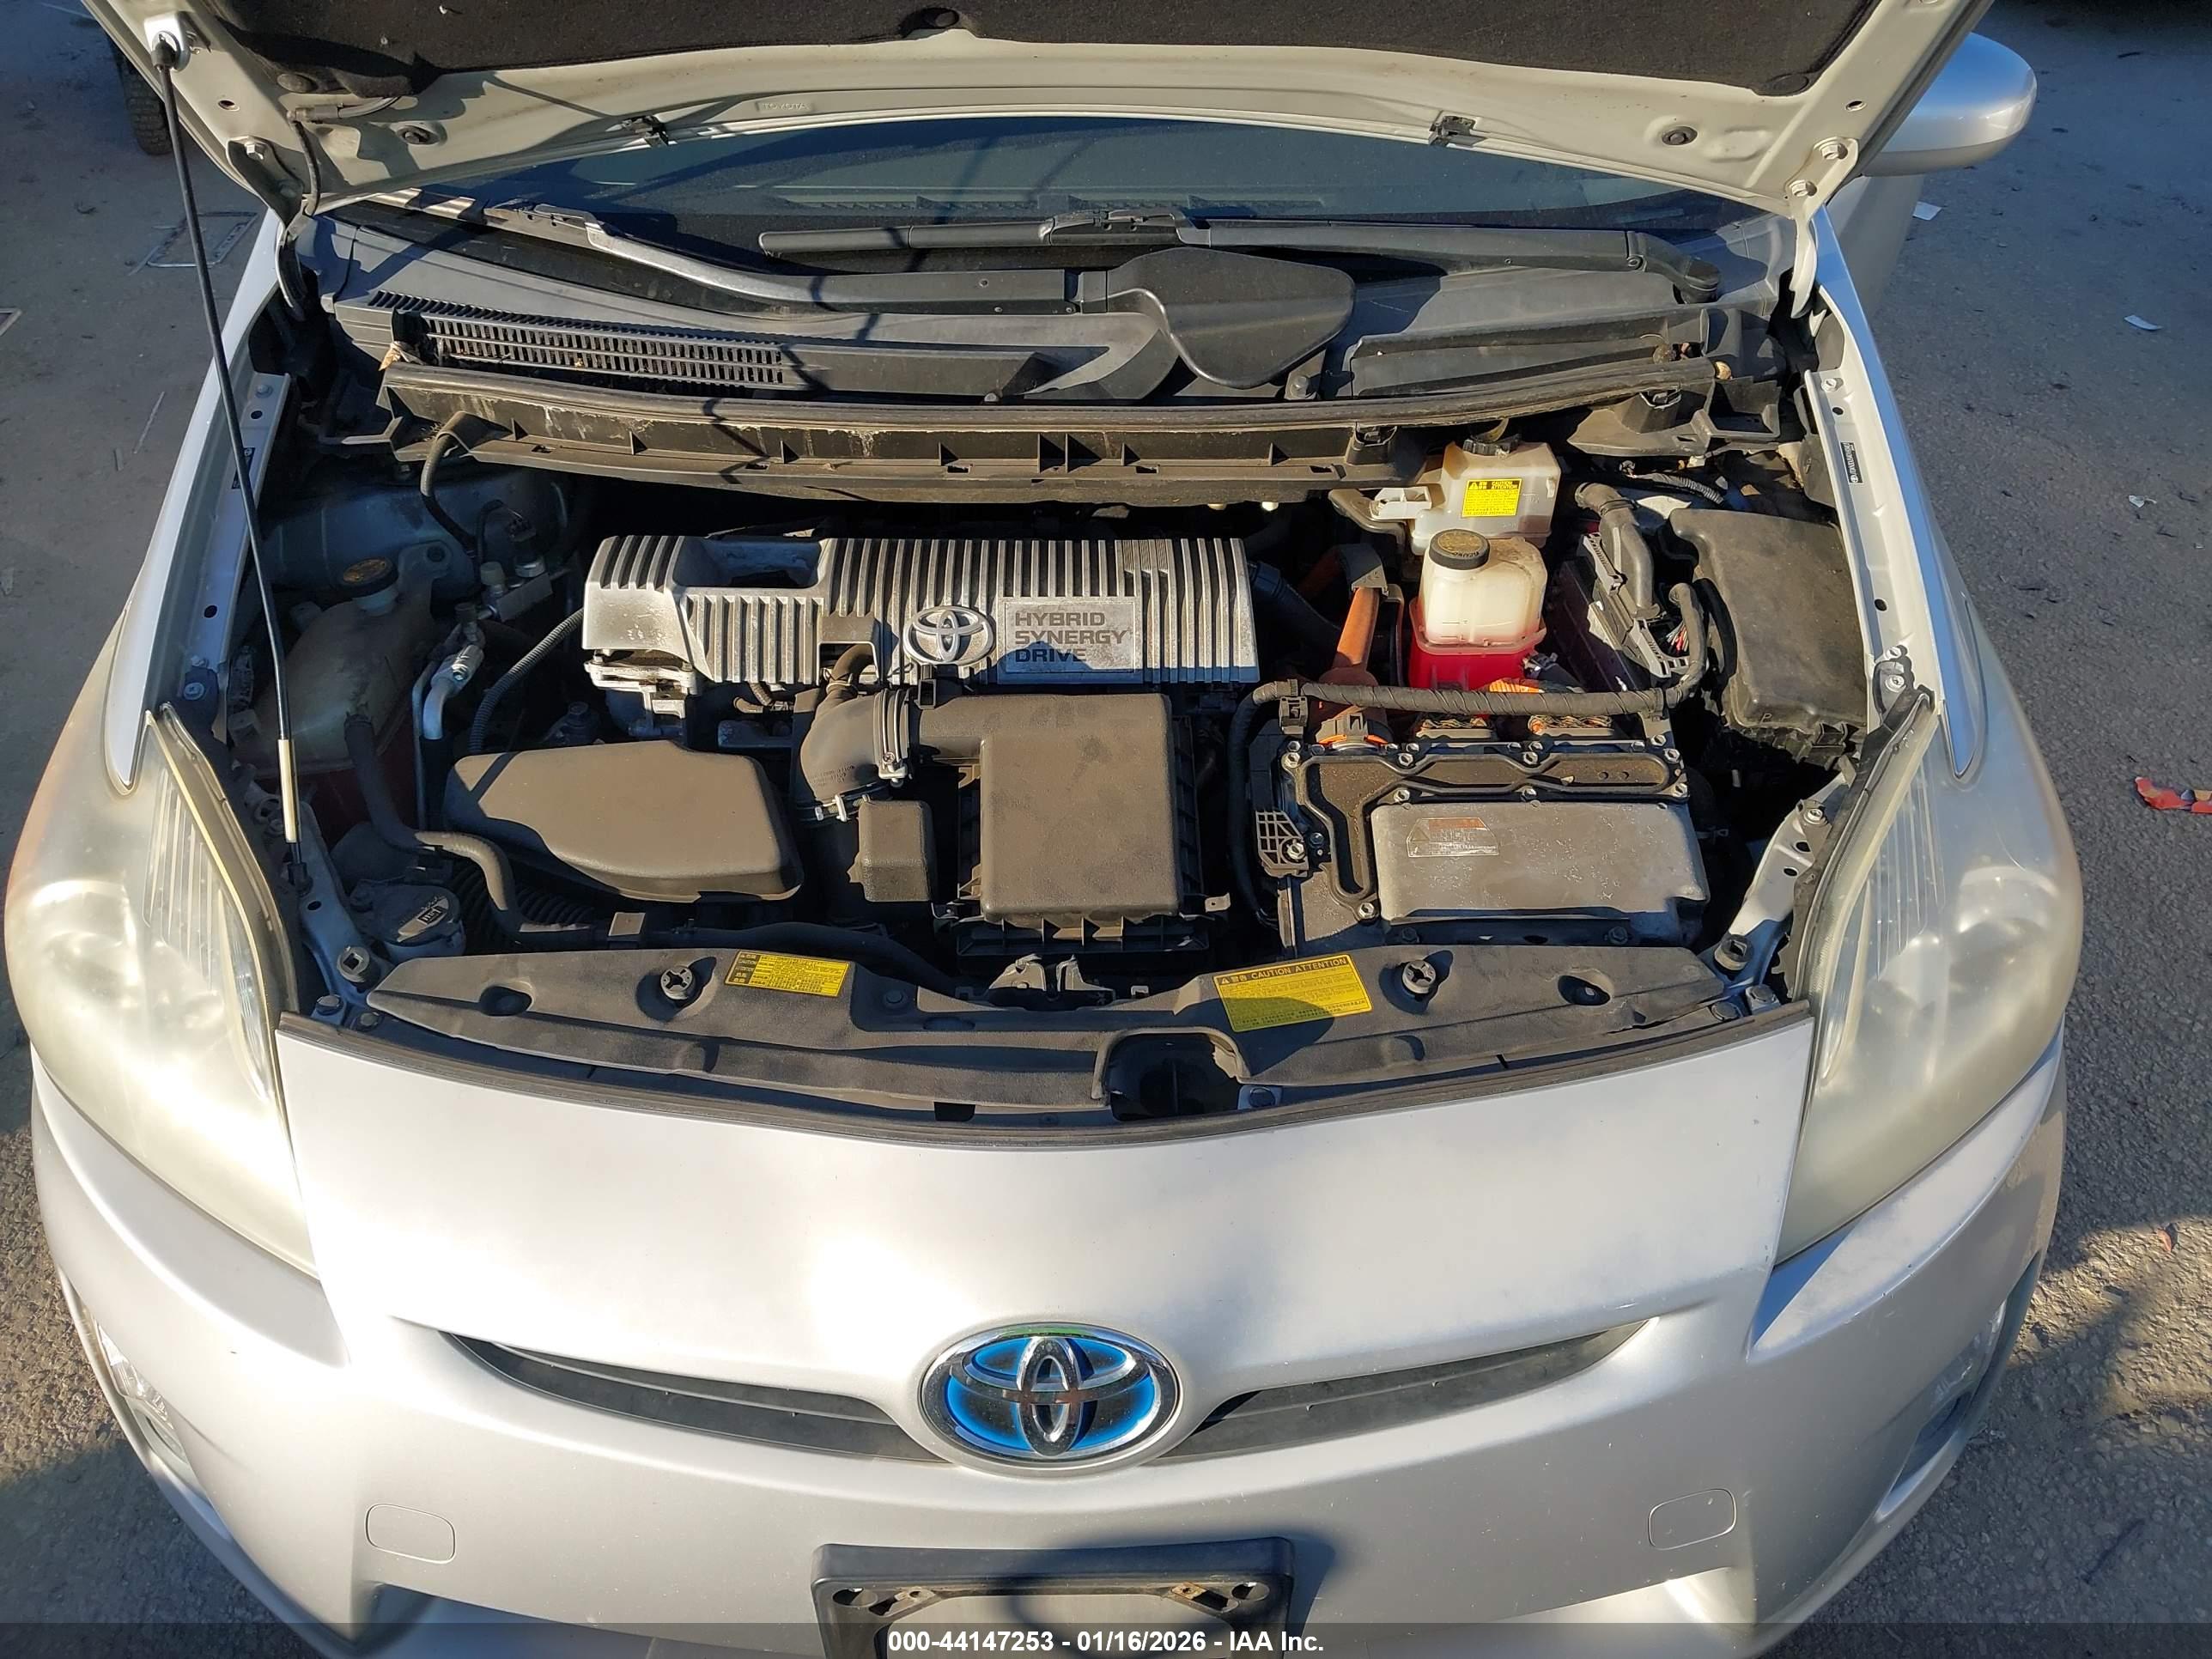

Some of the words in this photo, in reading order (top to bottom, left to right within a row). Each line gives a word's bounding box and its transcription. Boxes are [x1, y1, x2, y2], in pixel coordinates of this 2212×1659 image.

[1015, 612, 1105, 627] HYBRID
[1015, 630, 1128, 645] SYNERGY
[1015, 648, 1087, 663] DRIVE
[1251, 967, 1291, 980] CAUTION
[1295, 957, 1347, 973] ATTENTION
